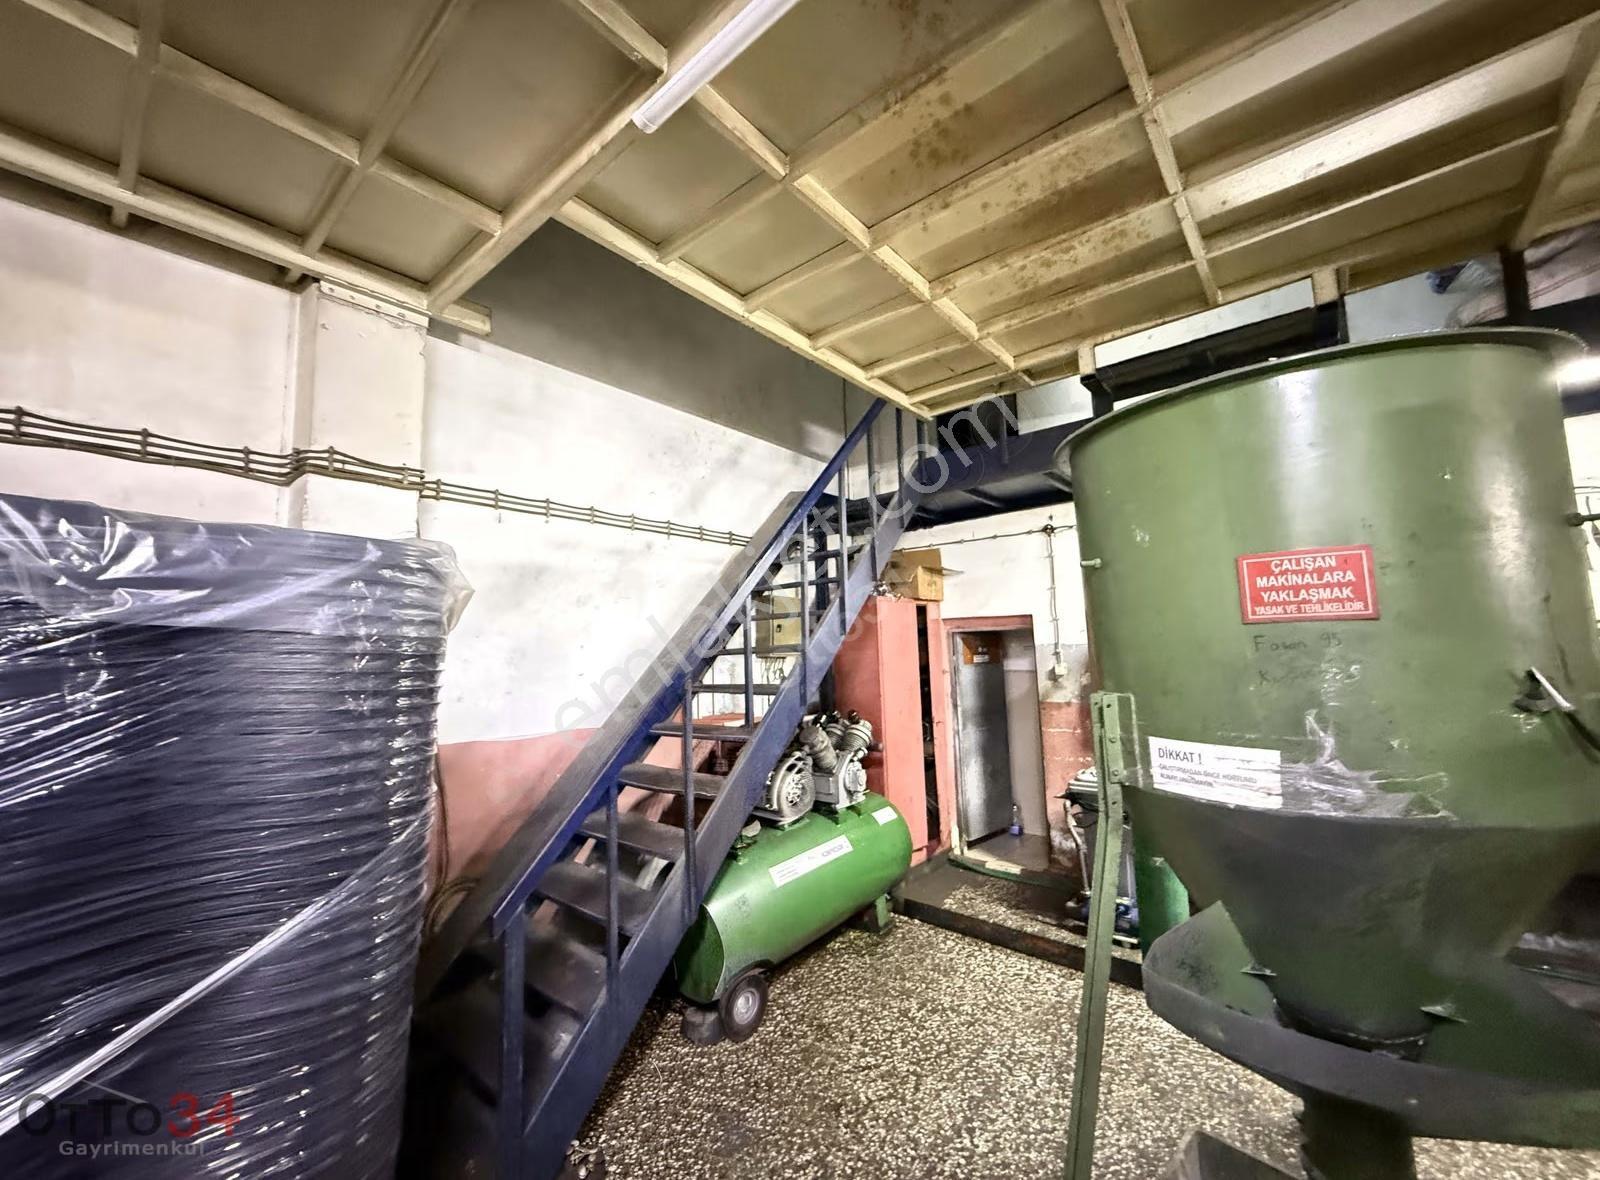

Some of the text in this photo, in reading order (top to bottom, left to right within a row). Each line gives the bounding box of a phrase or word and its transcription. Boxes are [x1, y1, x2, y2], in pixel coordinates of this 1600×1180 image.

[1271, 556, 1336, 574] ÇALIŞAN
[1256, 570, 1356, 588] MAKİNALARA
[1261, 586, 1354, 603] YAKLAŞMAK
[1254, 599, 1365, 615] YASAK VE TEHLİKELİDİR
[1158, 746, 1195, 763] DİKKAT
